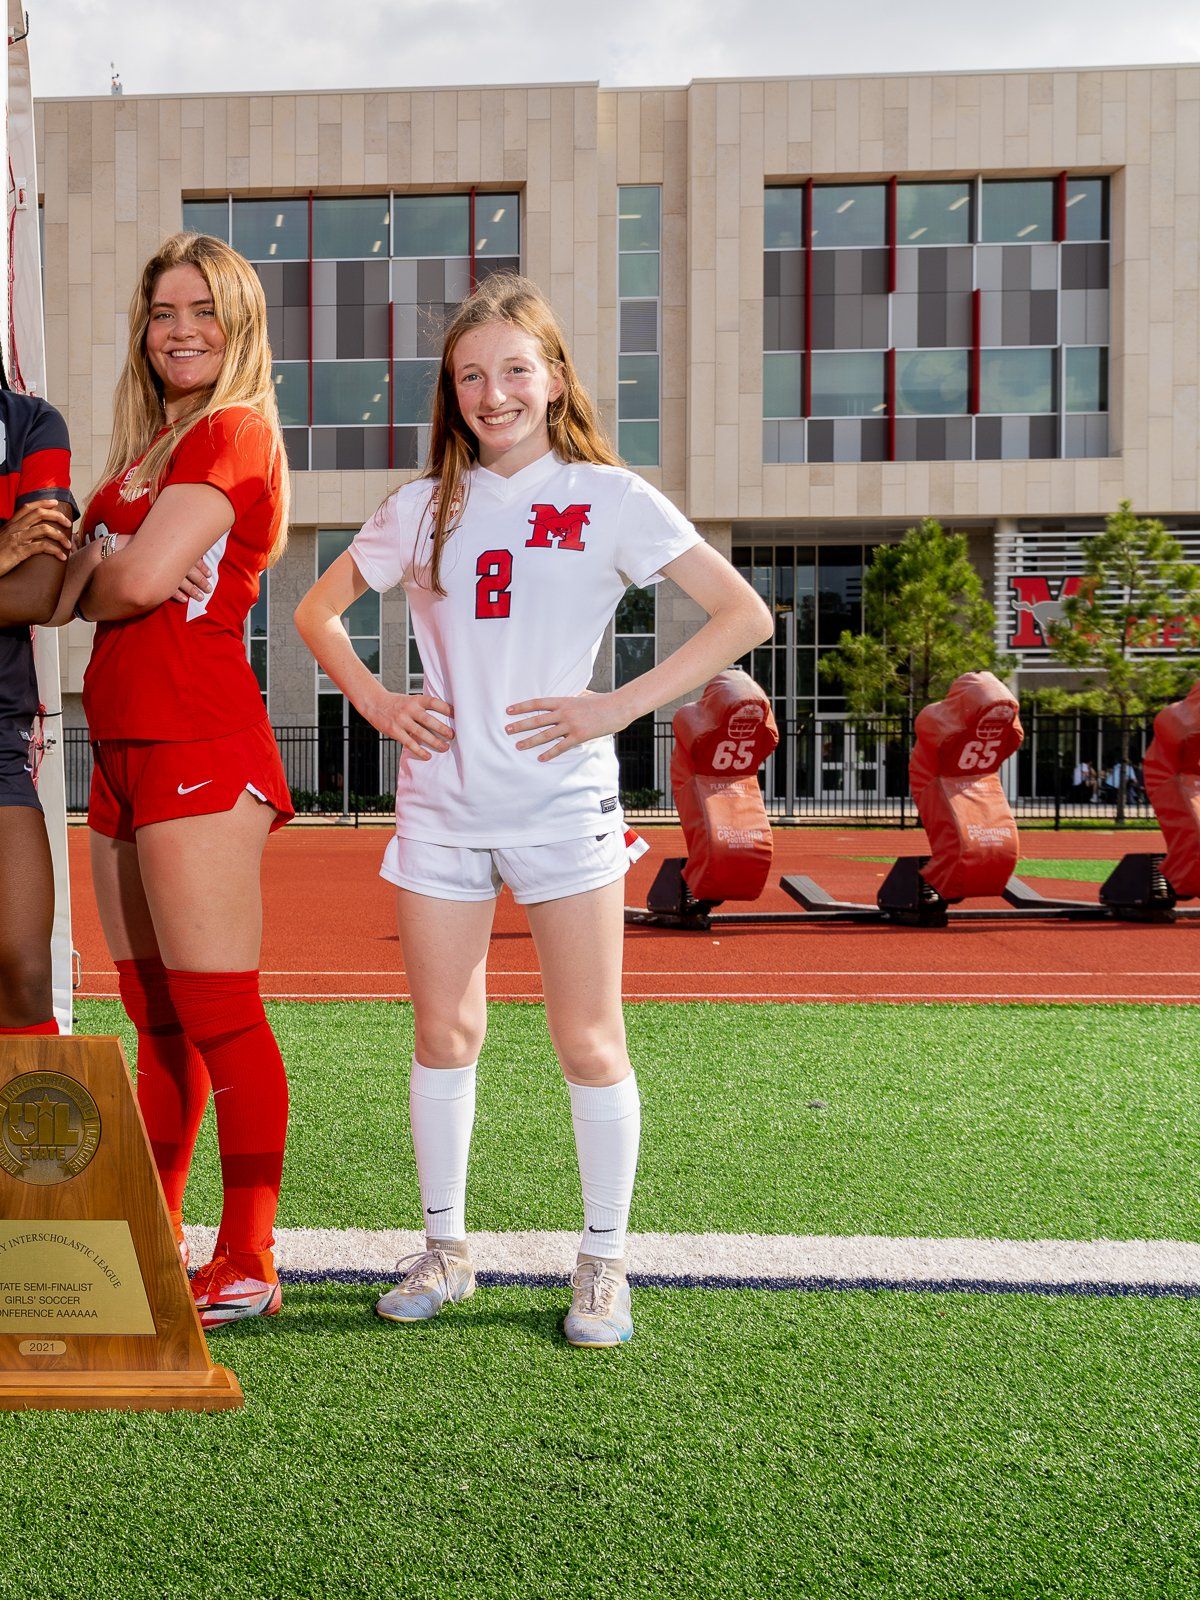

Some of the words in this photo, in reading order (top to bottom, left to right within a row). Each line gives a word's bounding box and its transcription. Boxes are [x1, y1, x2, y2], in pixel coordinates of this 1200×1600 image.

[525, 503, 591, 551] M
[475, 549, 514, 619] 2
[712, 740, 755, 770] 65
[958, 740, 1001, 770] 65
[21, 1146, 66, 1161] STATE
[70, 1128, 98, 1173] LEAGUE
[8, 1232, 95, 1259] INTERSCHOLASTIC
[93, 1255, 122, 1289] LEAGUE
[4, 1295, 36, 1305] GIRLS'
[38, 1295, 80, 1305] SOCCER
[23, 1282, 93, 1292] SEMI-FINALIST
[56, 1308, 98, 1318] AAAAAA
[29, 1342, 55, 1352] 2021
